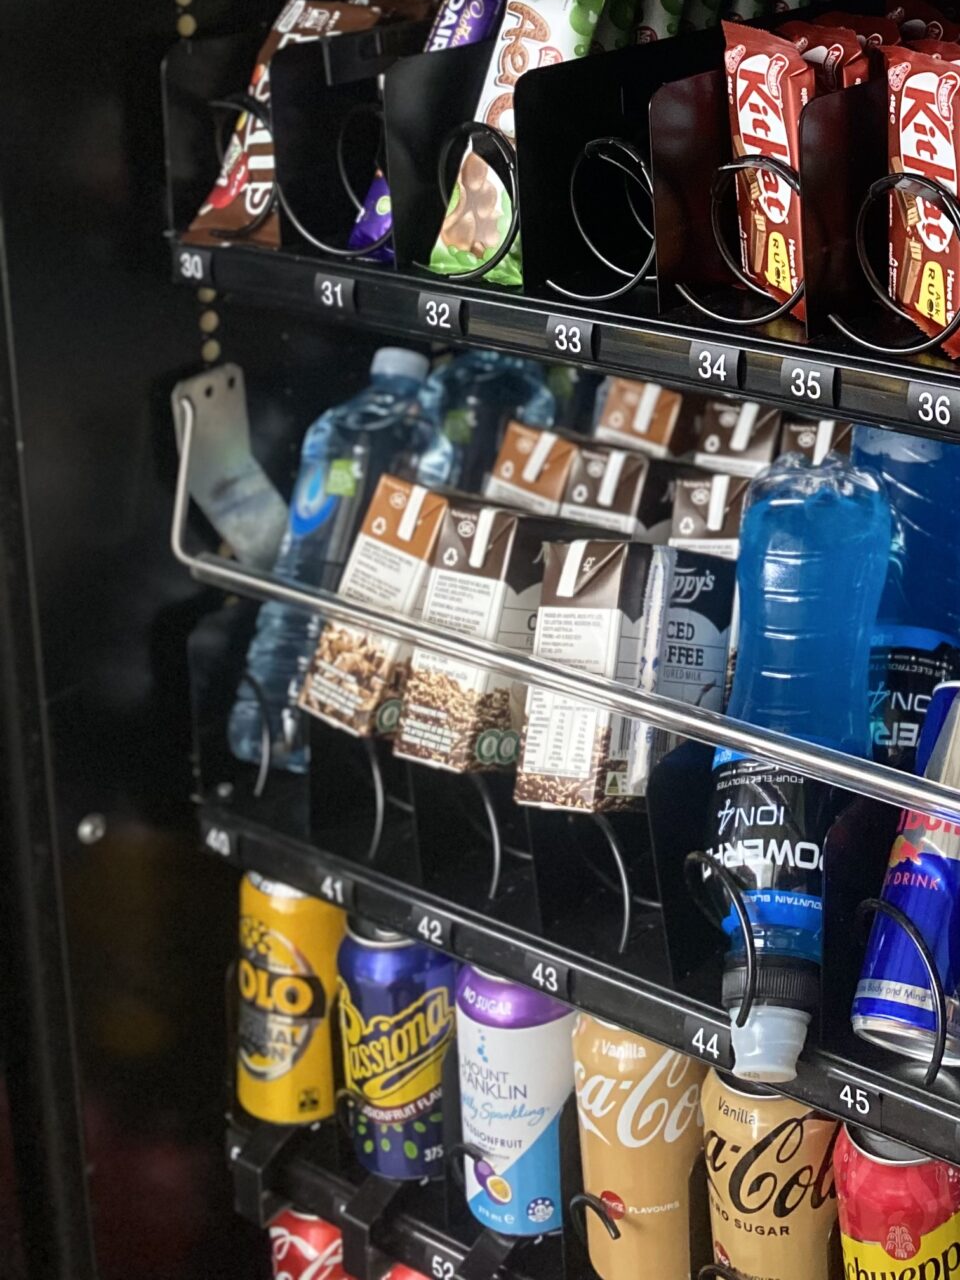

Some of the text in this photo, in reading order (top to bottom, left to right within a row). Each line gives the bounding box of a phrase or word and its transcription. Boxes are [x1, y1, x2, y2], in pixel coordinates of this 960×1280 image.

[179, 252, 203, 280] 30
[320, 281, 344, 308] 31
[425, 300, 451, 329] 32
[554, 324, 582, 353] 33
[698, 351, 726, 382] 34
[790, 368, 822, 399] 35
[918, 392, 951, 425] 36
[206, 827, 231, 856] 40
[321, 876, 343, 904] 41
[895, 873, 940, 891] DRINK
[417, 916, 444, 945] 42
[239, 958, 313, 1016] OLO
[532, 963, 558, 992] 43
[462, 985, 513, 1017] NO SUGAR
[600, 1038, 648, 1059] Vanilla
[692, 1028, 720, 1060] 44
[717, 1095, 758, 1126] Vanilla
[840, 1085, 870, 1115] 45
[628, 1200, 681, 1214] FLAVOURS
[734, 1218, 791, 1237] SUGAR
[431, 1255, 456, 1280] 52
